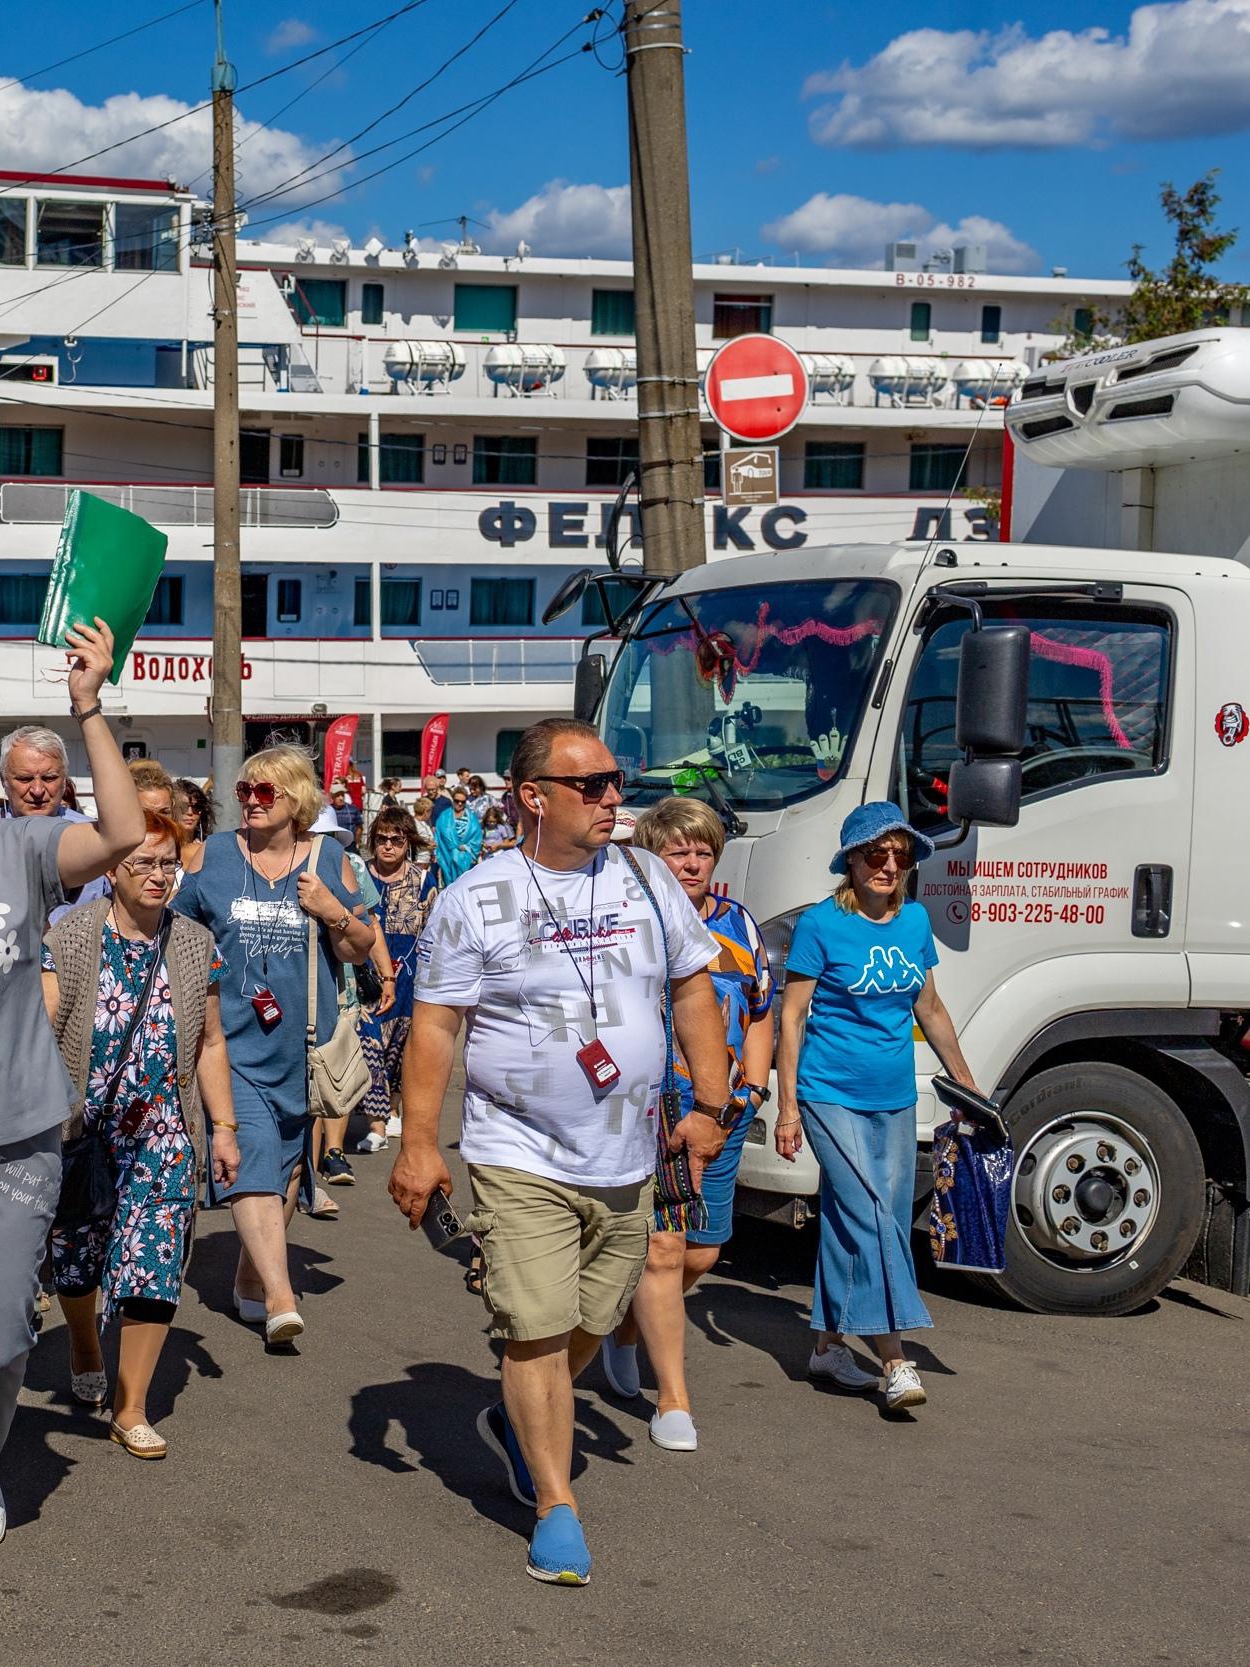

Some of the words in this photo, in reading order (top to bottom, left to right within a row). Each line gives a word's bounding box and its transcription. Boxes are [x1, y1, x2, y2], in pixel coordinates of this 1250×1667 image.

[479, 501, 808, 551] ФЕЛКС
[333, 739, 346, 774] TRAVEL
[947, 860, 970, 877] МЫ
[973, 861, 1014, 880] ИЩЕМ
[1017, 862, 1108, 881] СОТРУДНИКОВ
[923, 881, 977, 897] ДОСТОЙНАЯ
[979, 884, 1029, 899] ЗАРПЛАТА,
[1031, 884, 1091, 899] СТАБИЛЬНЫЙ
[1093, 886, 1129, 899] ГРАФИК
[971, 902, 1105, 925] 8-903-225-48-00
[5, 1163, 25, 1179] will
[22, 1171, 42, 1188] put
[11, 1187, 35, 1206] your
